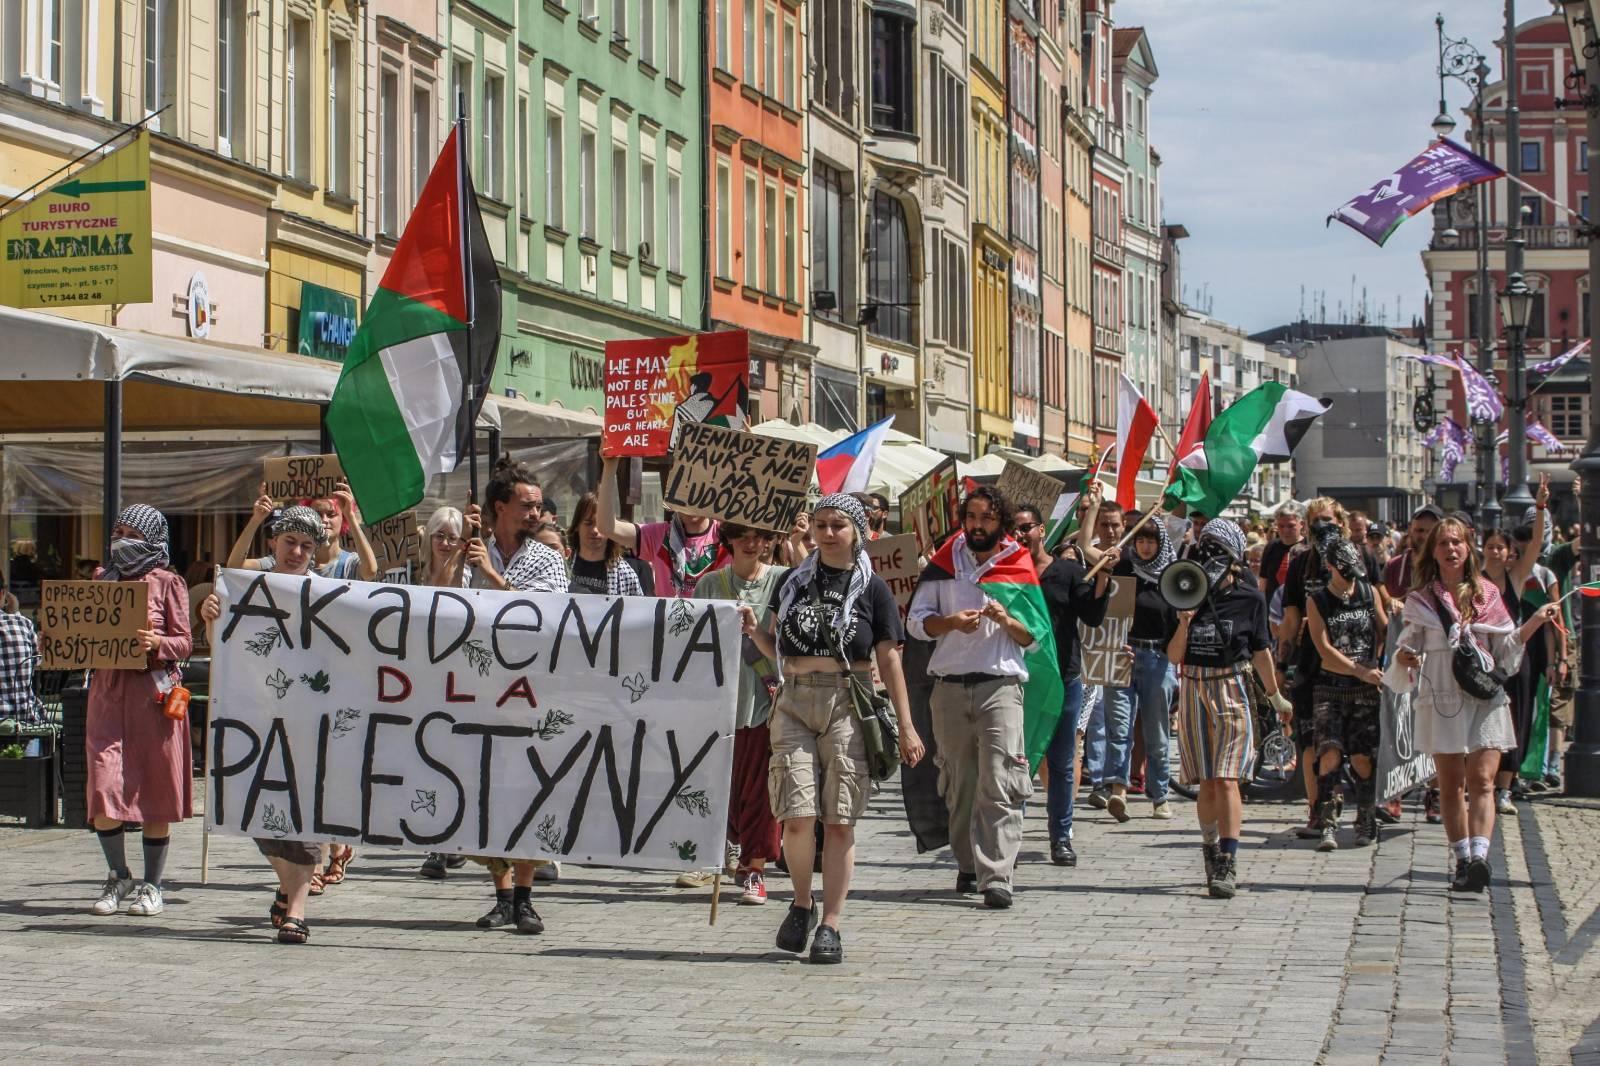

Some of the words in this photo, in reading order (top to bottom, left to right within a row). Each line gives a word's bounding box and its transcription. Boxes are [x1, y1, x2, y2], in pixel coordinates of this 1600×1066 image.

[48, 202, 91, 214] BIURO
[22, 217, 119, 232] TURYSTYCZNE
[6, 233, 133, 261] BRATNIAK
[62, 265, 87, 274] Rynek
[48, 294, 60, 302] 71
[60, 293, 76, 301] 344
[78, 292, 89, 301] 82
[91, 292, 102, 300] 48
[609, 358, 631, 376] WE
[635, 356, 672, 375] MAY
[607, 381, 631, 392] NOT
[634, 379, 648, 391] BE
[653, 378, 668, 390] IN
[626, 408, 649, 420] BUT
[608, 423, 632, 433] OUR
[635, 420, 671, 431] HEARTS
[623, 433, 649, 447] ARE
[784, 442, 811, 464] NA
[288, 457, 324, 477] STOP
[901, 478, 932, 519] FREE
[869, 547, 904, 574] THE
[784, 623, 810, 654] HUMAN
[376, 665, 538, 709] DLA
[209, 710, 720, 859] PALESTYNY
